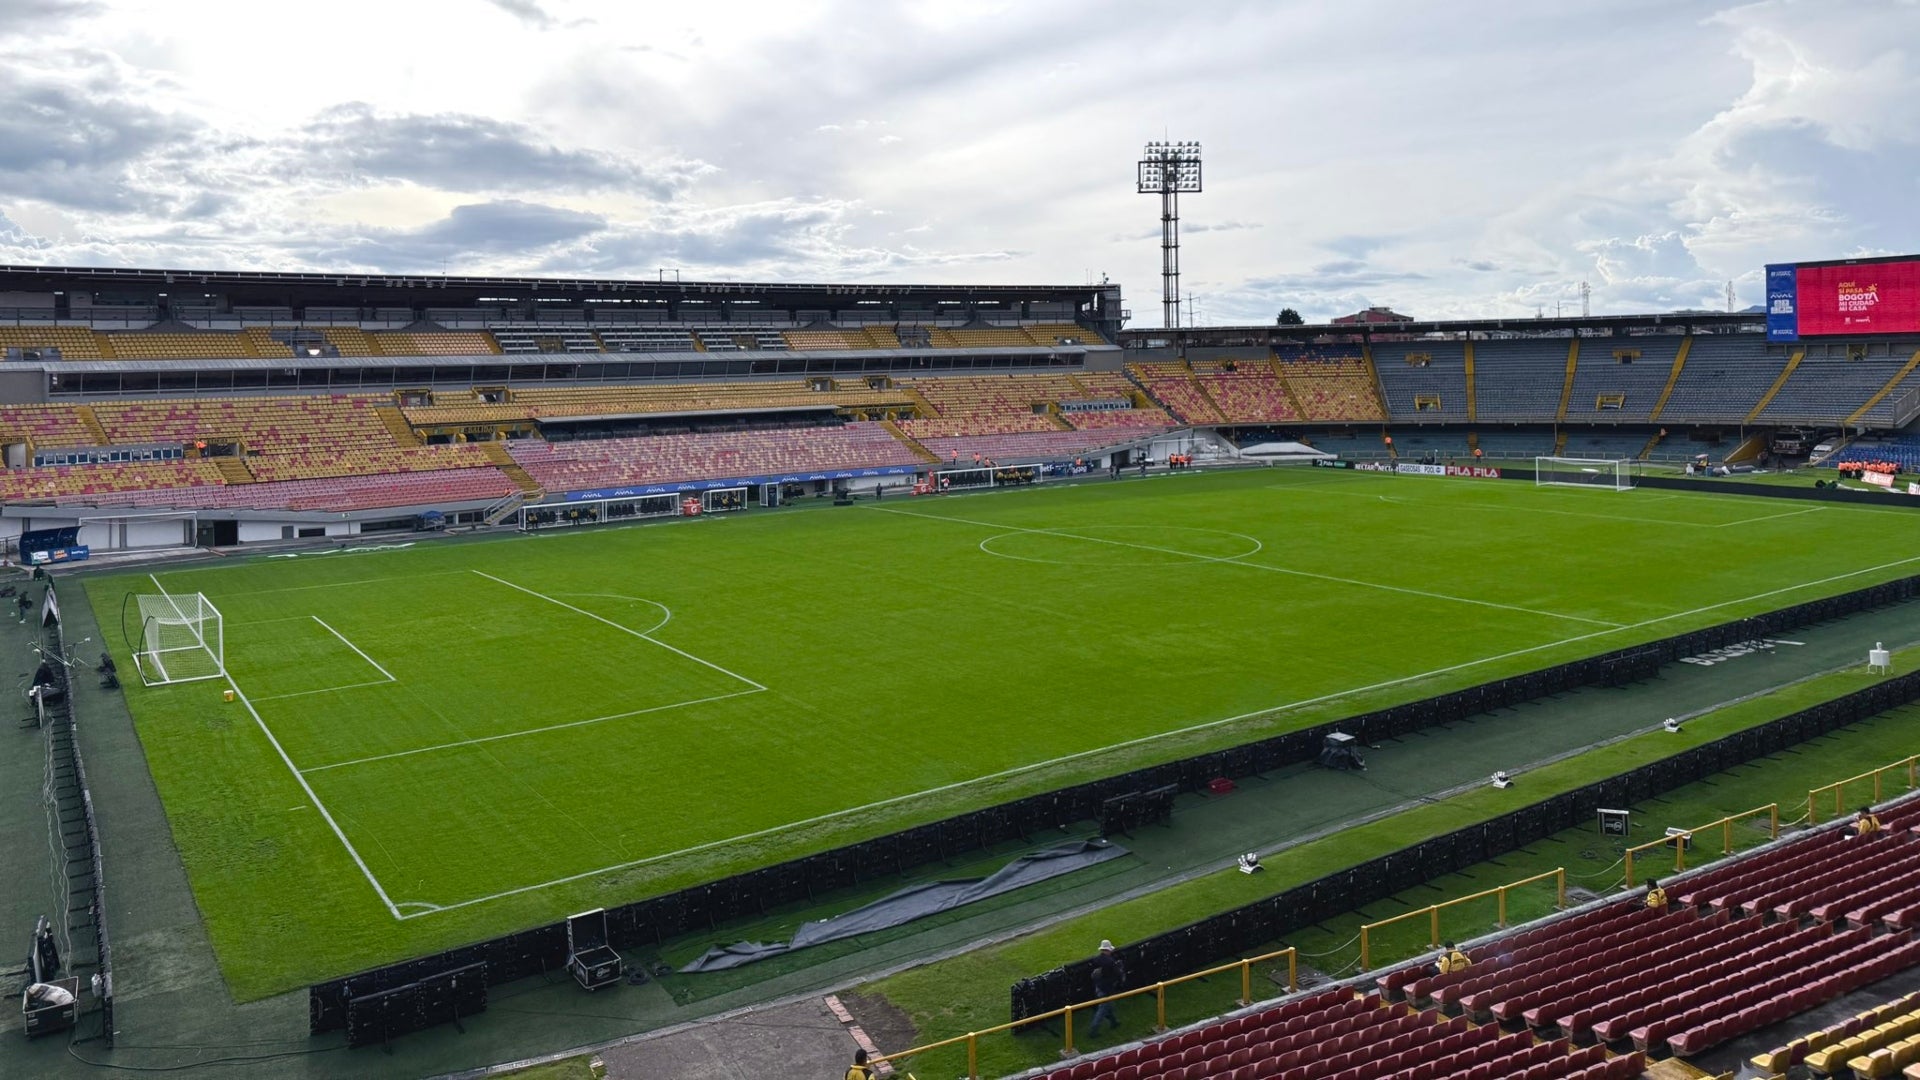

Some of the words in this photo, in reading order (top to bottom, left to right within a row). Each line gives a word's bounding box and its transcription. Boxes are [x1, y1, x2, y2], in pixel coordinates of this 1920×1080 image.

[1355, 463, 1375, 471] NECTAR
[1400, 464, 1420, 473] GASEOSAS
[1447, 466, 1471, 476] FILA
[1473, 468, 1498, 478] FILA
[920, 485, 927, 493] G
